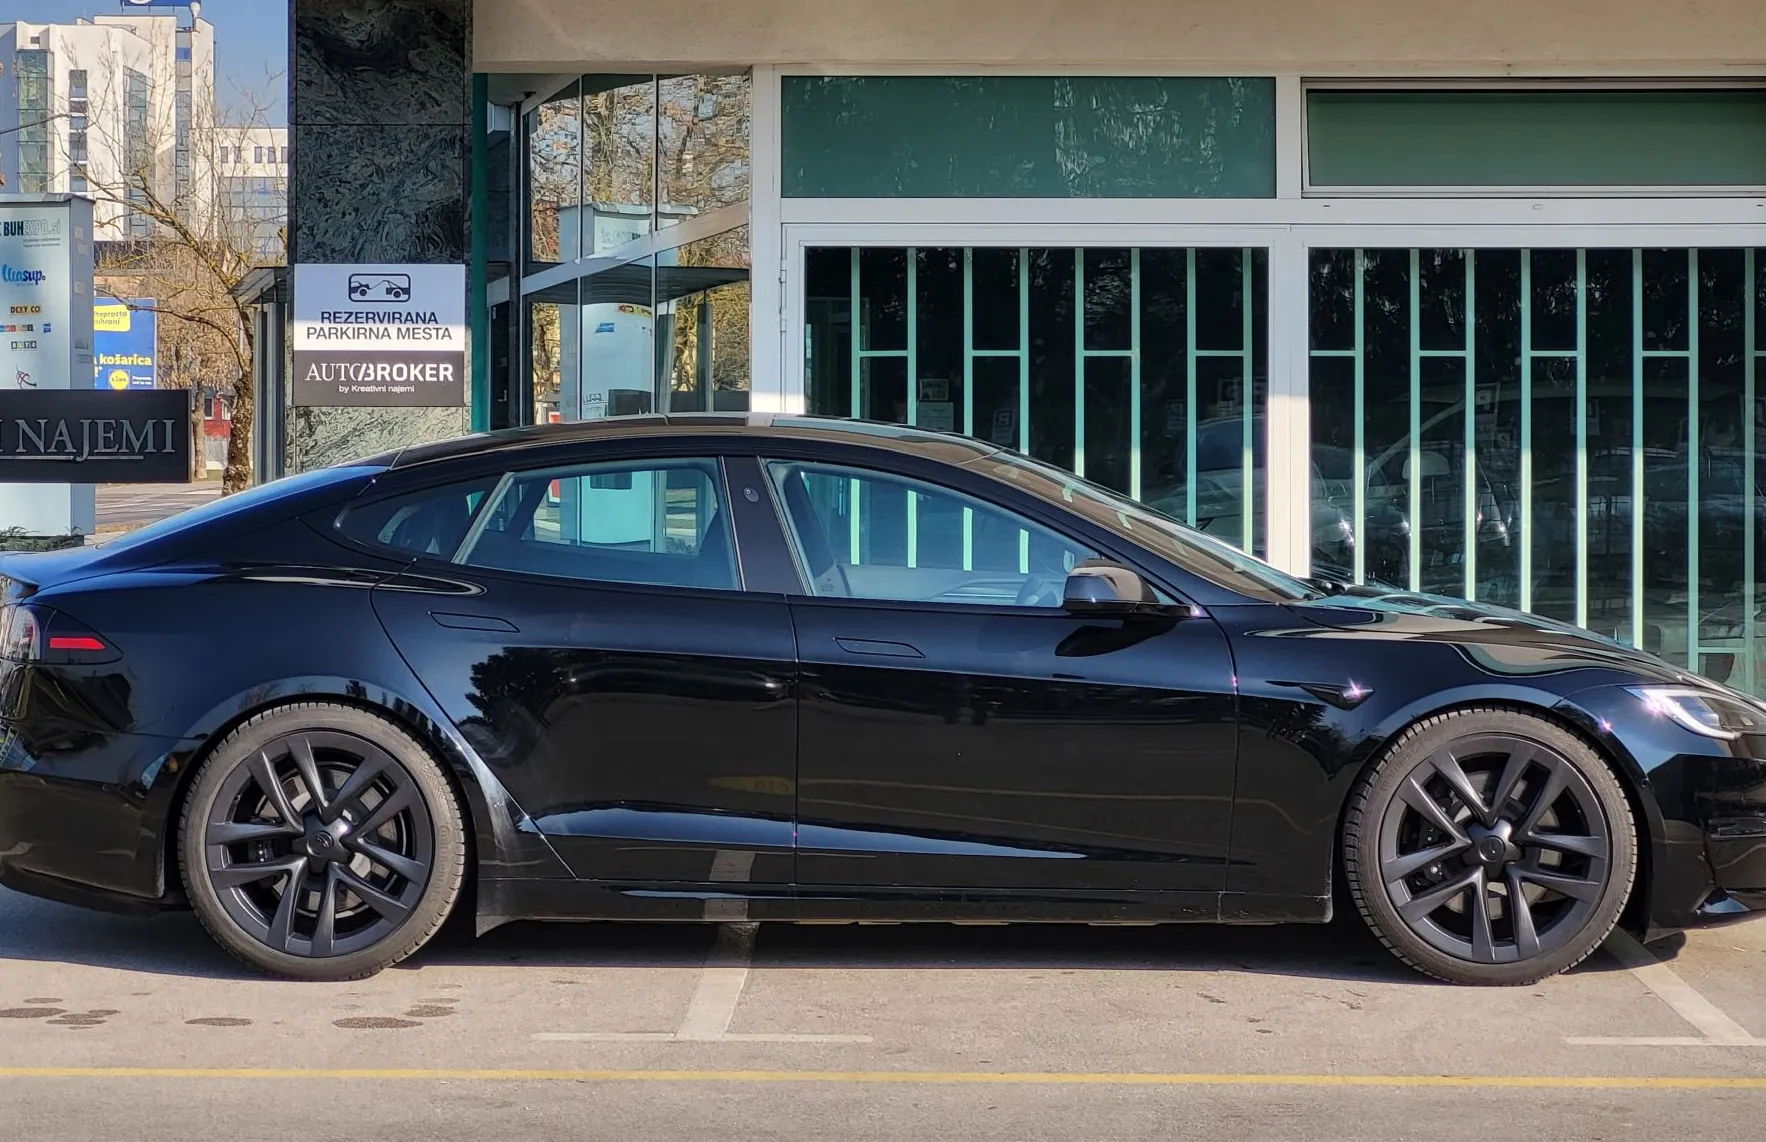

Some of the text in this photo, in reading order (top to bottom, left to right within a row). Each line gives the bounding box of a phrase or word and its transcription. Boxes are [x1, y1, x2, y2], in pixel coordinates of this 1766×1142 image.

[10, 306, 28, 314] DEXY
[320, 311, 438, 325] REZERVIRANA
[306, 327, 453, 340] PARKIRNA MESTA
[99, 353, 152, 366] košarica
[338, 385, 415, 394] by Kreativni najemi
[14, 418, 176, 462] NAJEMI
